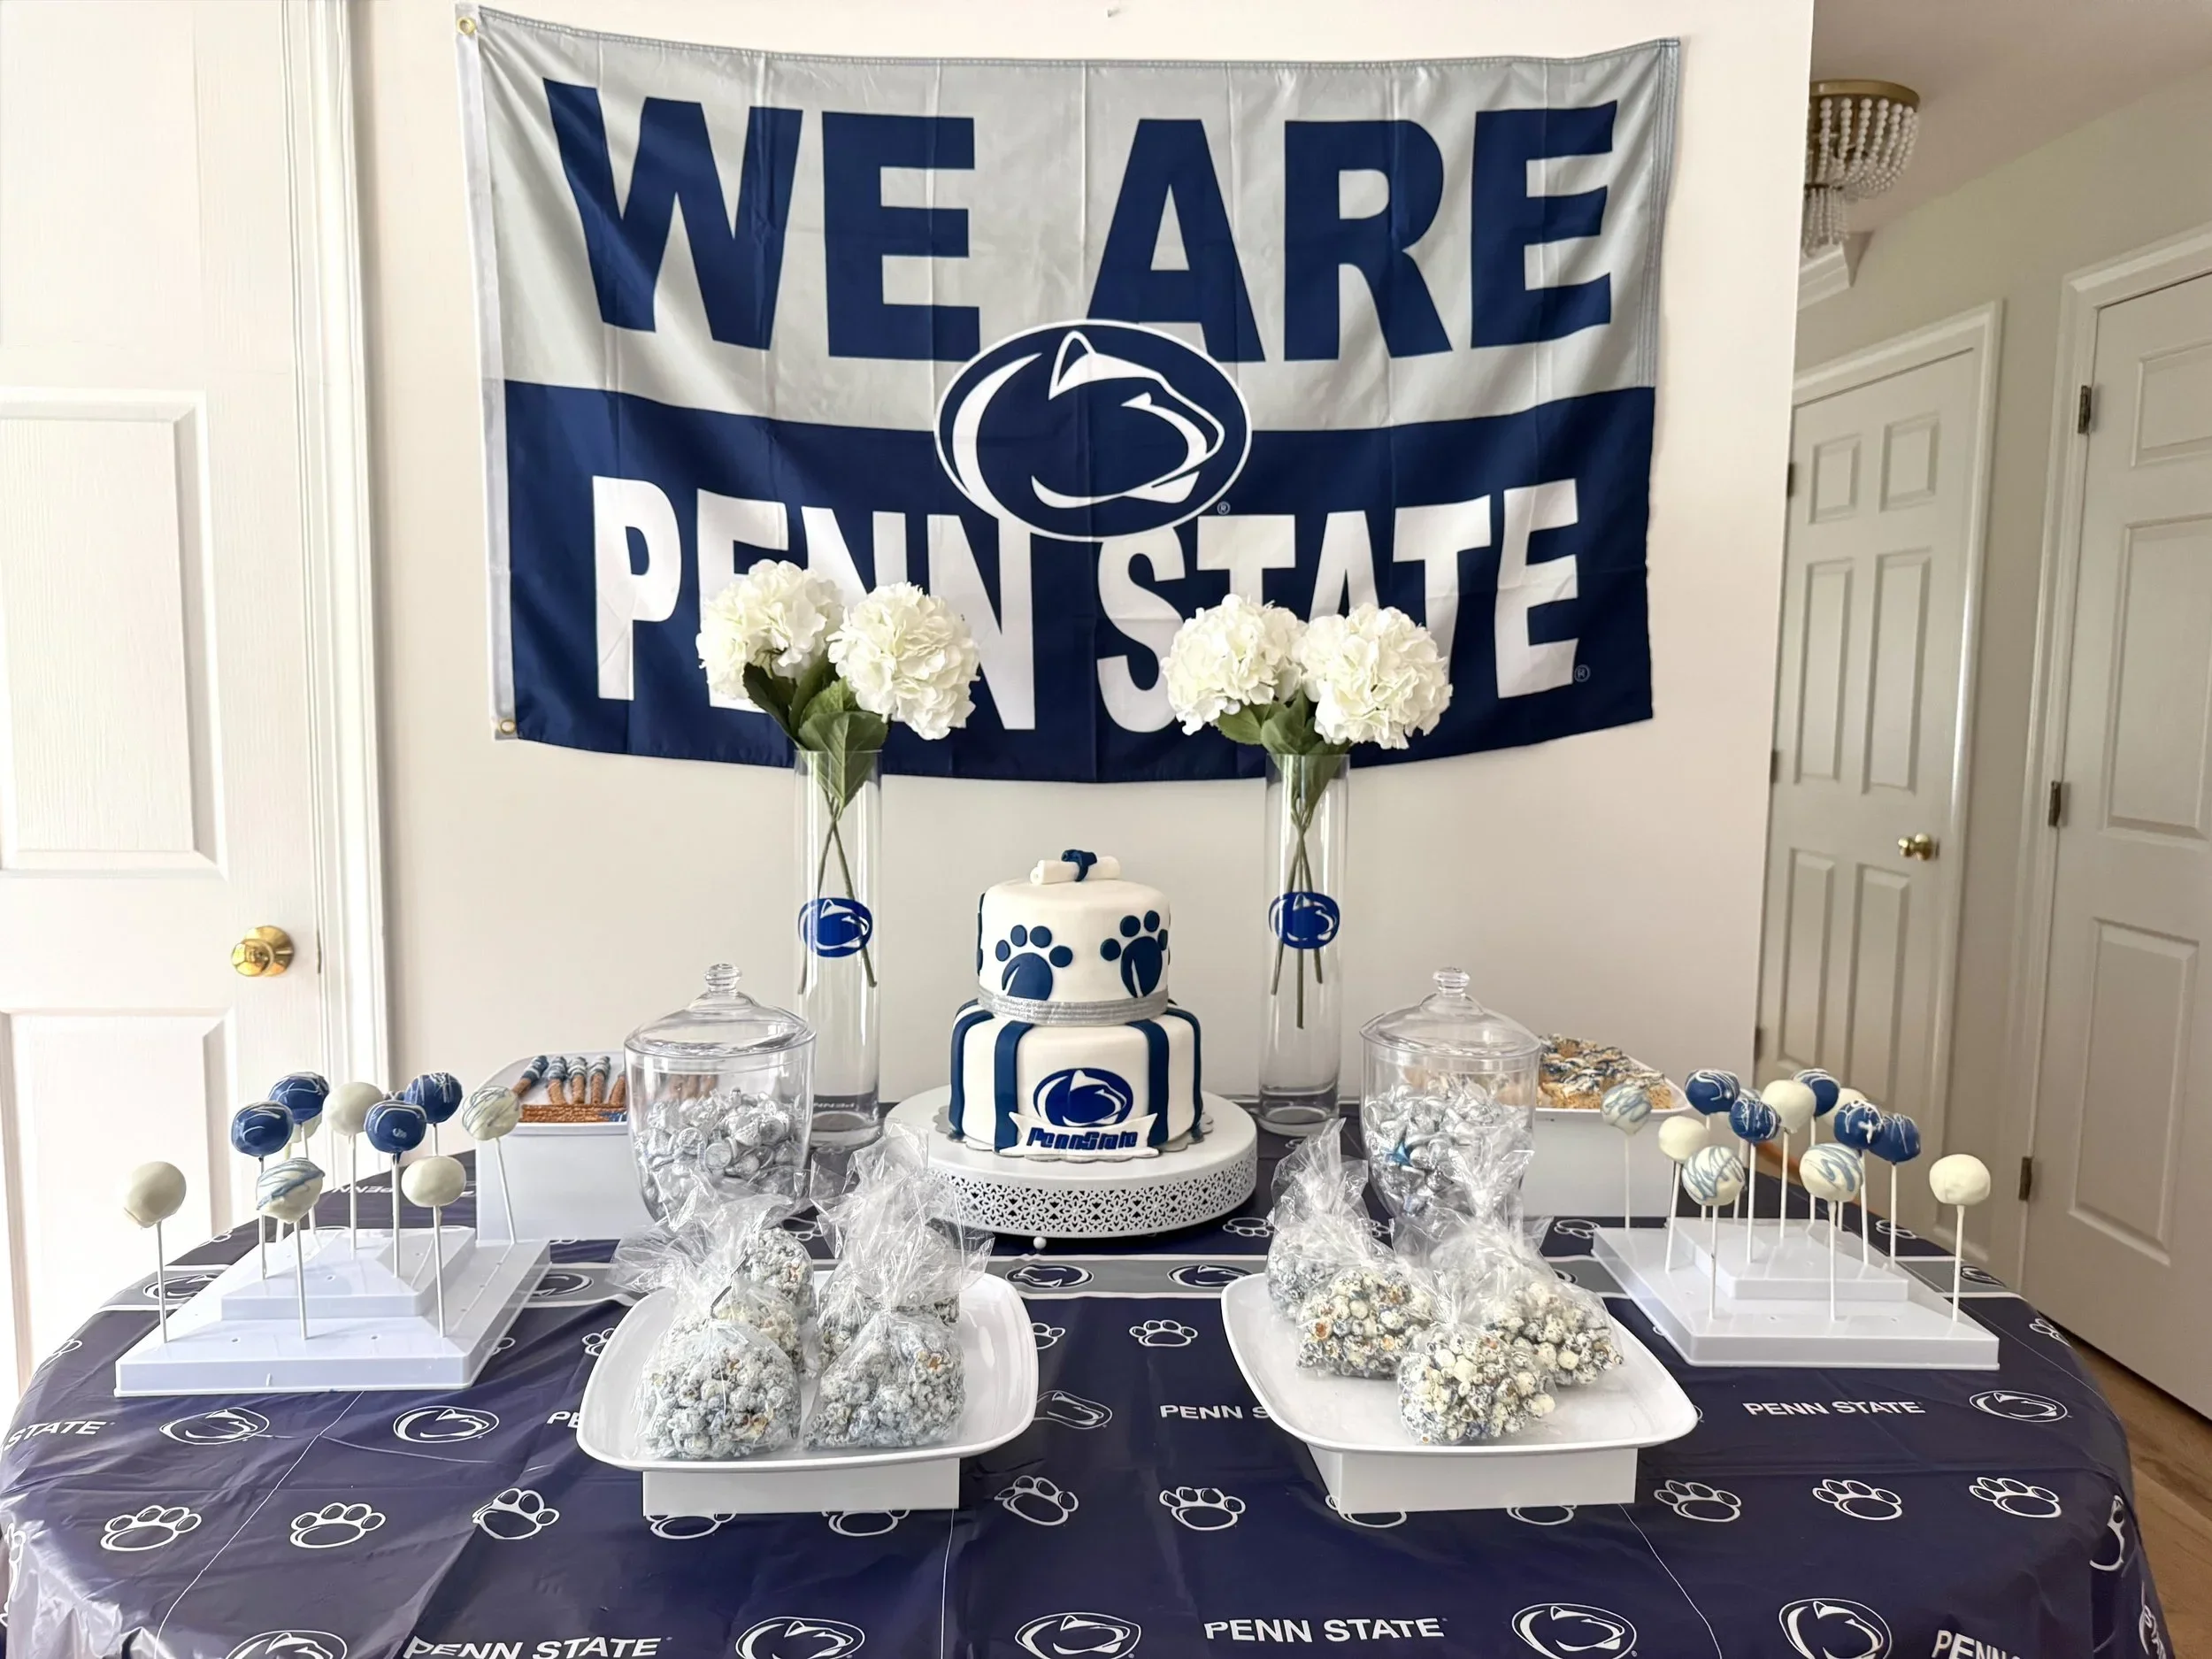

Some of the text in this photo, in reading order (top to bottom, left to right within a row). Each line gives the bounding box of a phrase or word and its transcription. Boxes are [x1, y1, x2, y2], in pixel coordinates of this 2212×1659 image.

[542, 77, 1618, 362] WE ARE
[1160, 1404, 1243, 1420] PENN
[1742, 1401, 1926, 1416] PENN STATE
[3, 1420, 107, 1452] STATE
[1203, 1617, 1445, 1643] PENN STATE
[403, 1635, 662, 1659] PENN STATE
